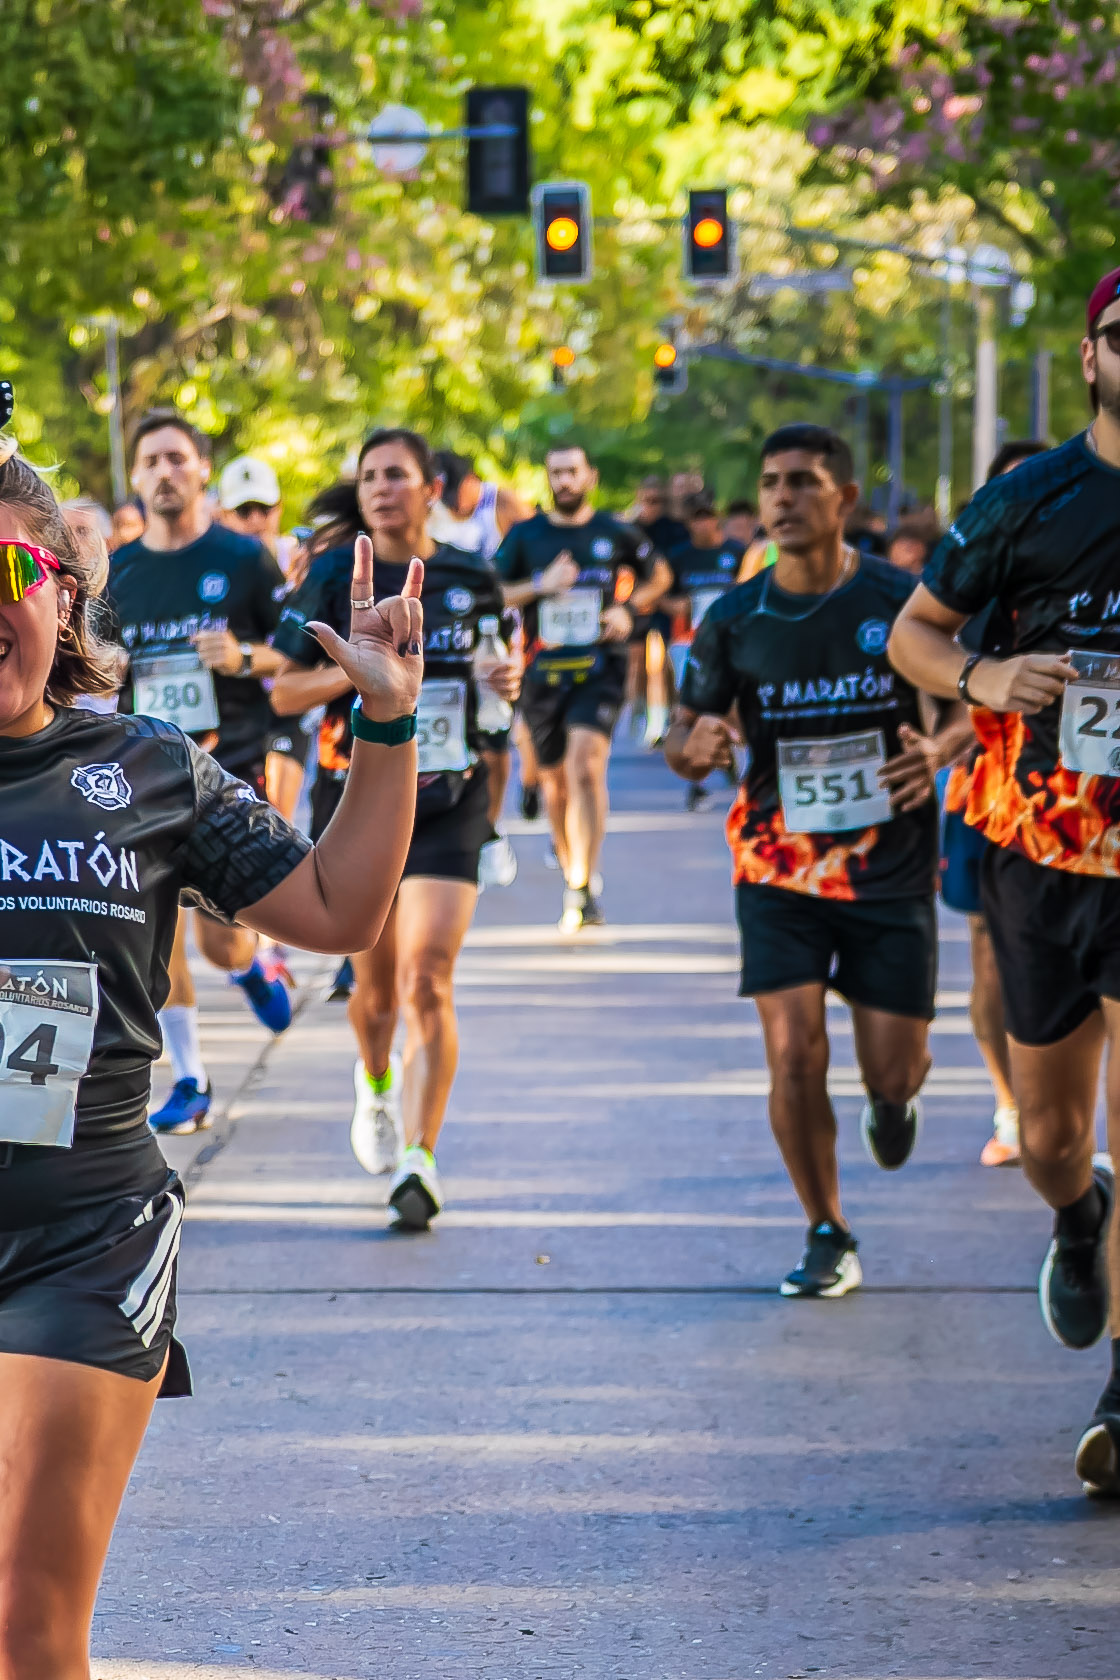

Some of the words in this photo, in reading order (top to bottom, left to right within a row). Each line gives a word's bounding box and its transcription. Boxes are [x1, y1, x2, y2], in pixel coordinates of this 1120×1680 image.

[144, 681, 201, 711] 280
[795, 769, 874, 807] 551
[18, 897, 108, 916] VOLUNTARIOS
